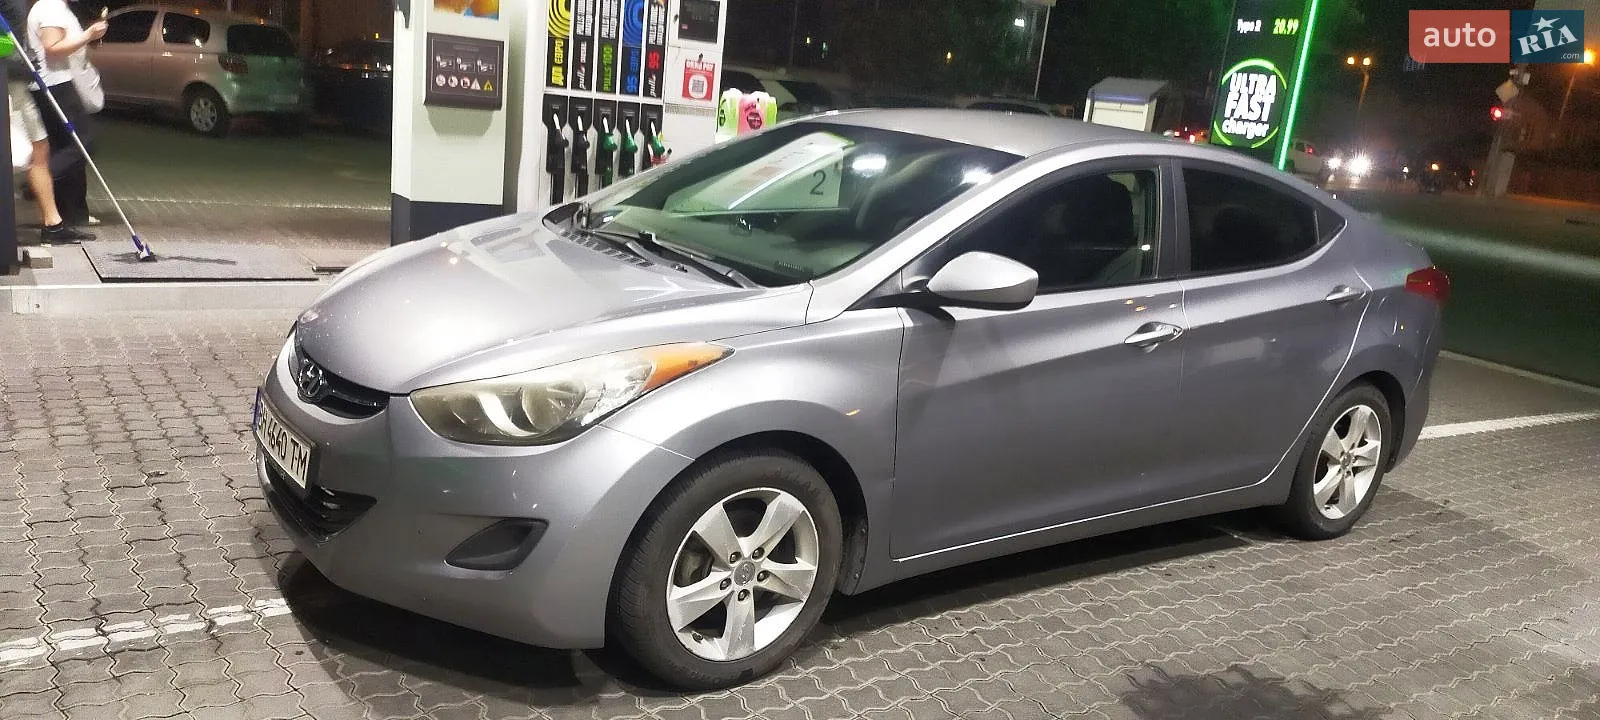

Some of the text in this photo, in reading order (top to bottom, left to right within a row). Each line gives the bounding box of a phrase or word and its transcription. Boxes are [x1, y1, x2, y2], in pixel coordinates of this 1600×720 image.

[1229, 72, 1277, 100] ULTRA
[1224, 91, 1275, 121] FAST
[1222, 117, 1270, 139] charger
[268, 417, 288, 461] 4640
